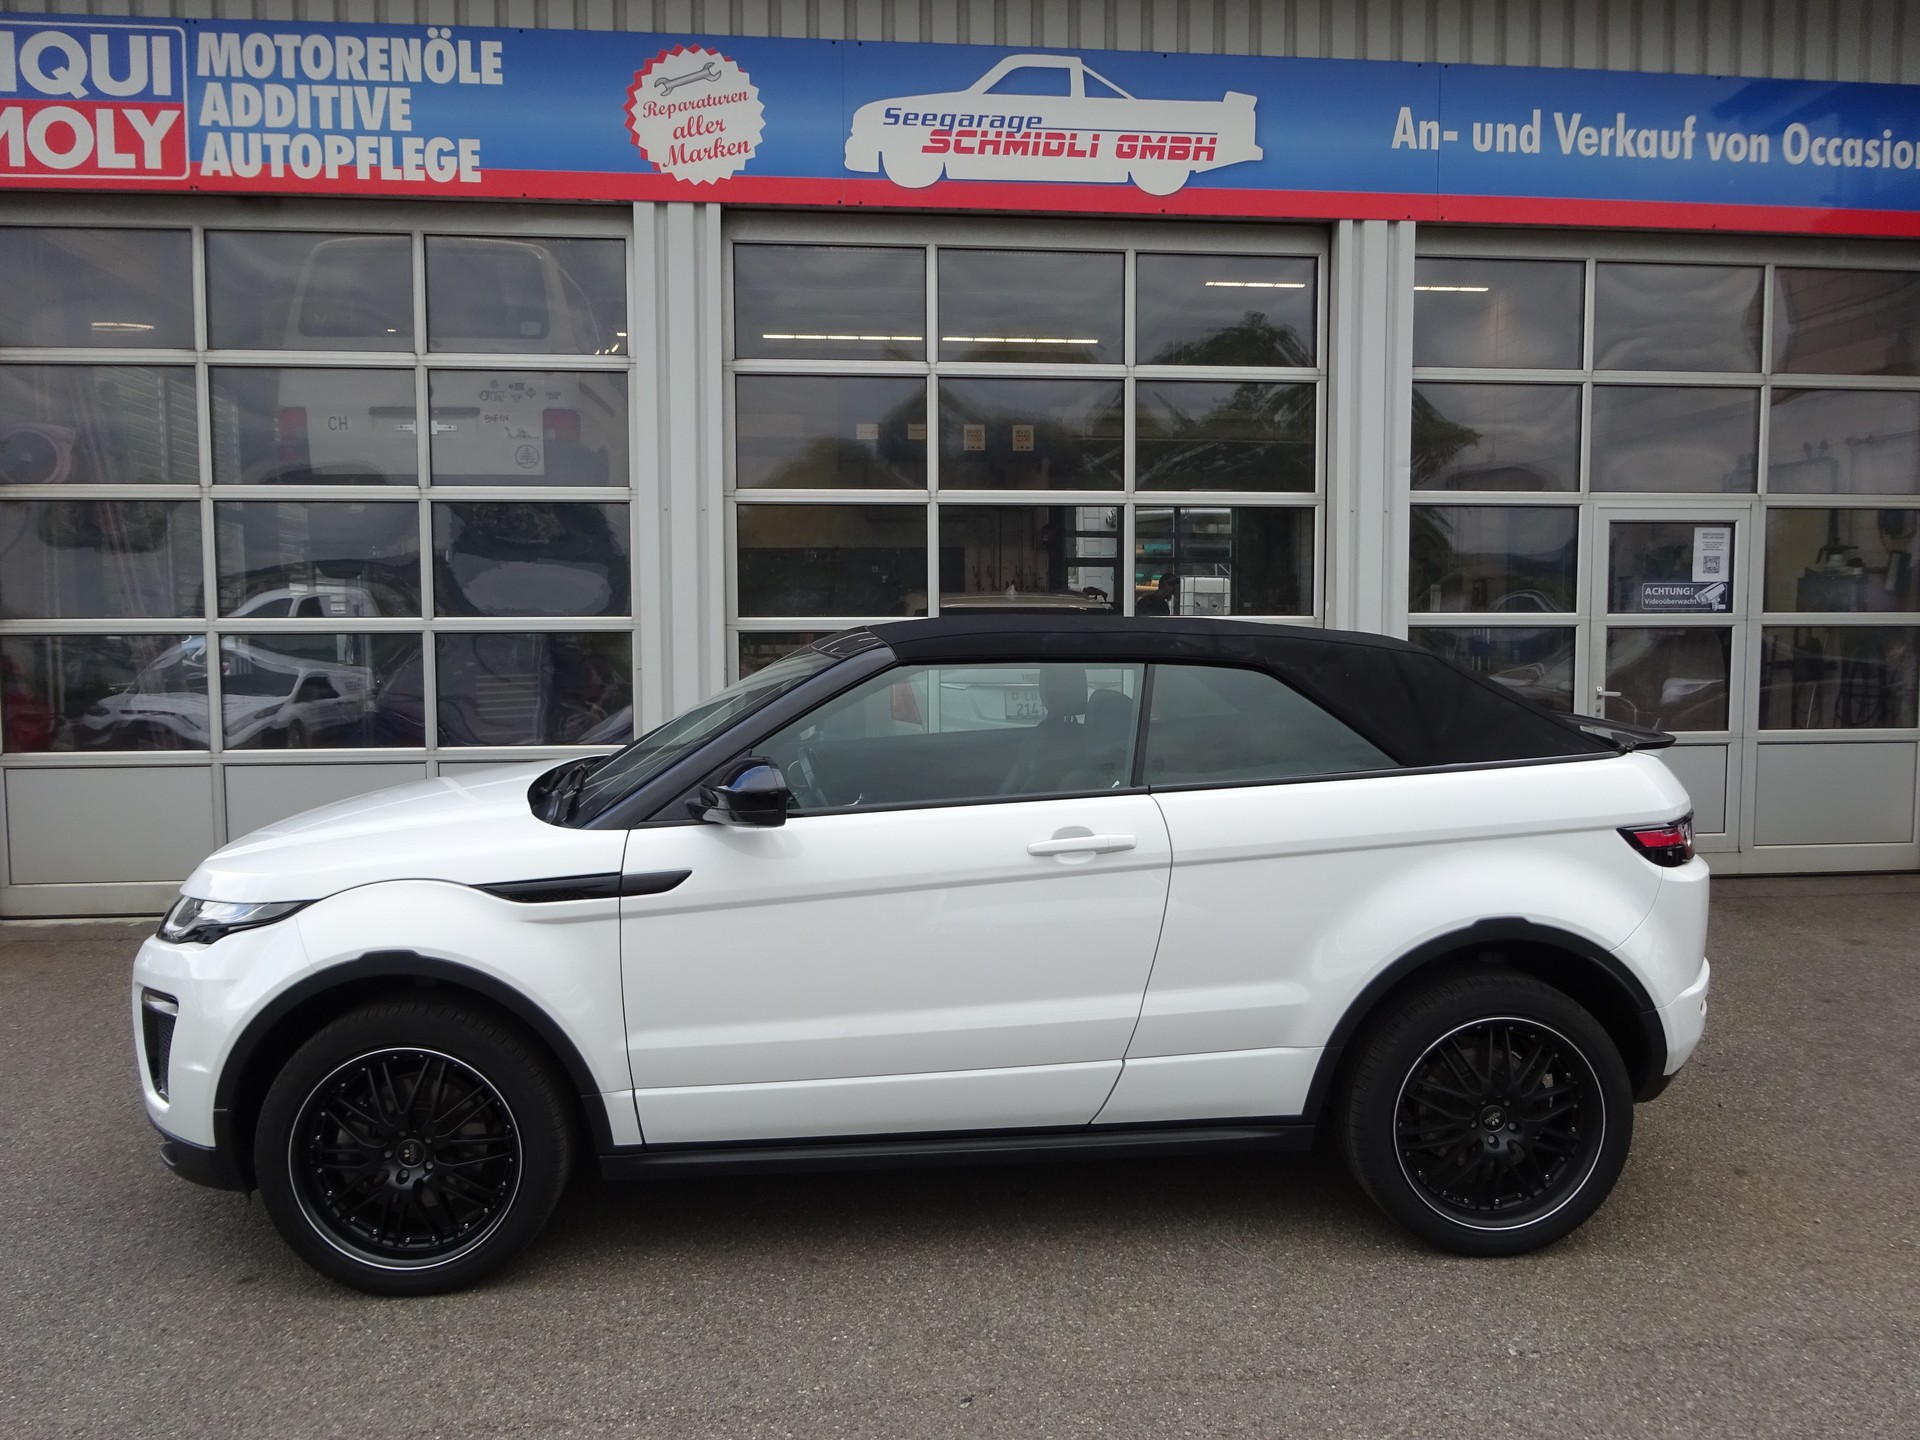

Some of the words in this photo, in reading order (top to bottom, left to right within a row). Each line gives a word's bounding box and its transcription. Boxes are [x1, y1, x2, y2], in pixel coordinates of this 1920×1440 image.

[197, 27, 503, 85] MOTORENÖLE
[199, 82, 412, 132] ADDITIVE
[642, 91, 749, 119] Reparaturen
[883, 107, 1043, 133] Seegarage
[672, 114, 727, 140] aller
[1391, 106, 1458, 150] An-
[1472, 109, 1541, 154] und
[1553, 112, 1697, 160] Verkauf
[1706, 131, 1769, 163] von
[1782, 122, 1920, 169] Occasio
[200, 132, 482, 183] AUTOPFLEGE
[662, 137, 751, 168] Marken
[921, 129, 1100, 158] SCHMIDLI
[1115, 134, 1217, 161] GMBH
[327, 415, 348, 431] CH
[1644, 587, 1694, 596] ACHTUNG!
